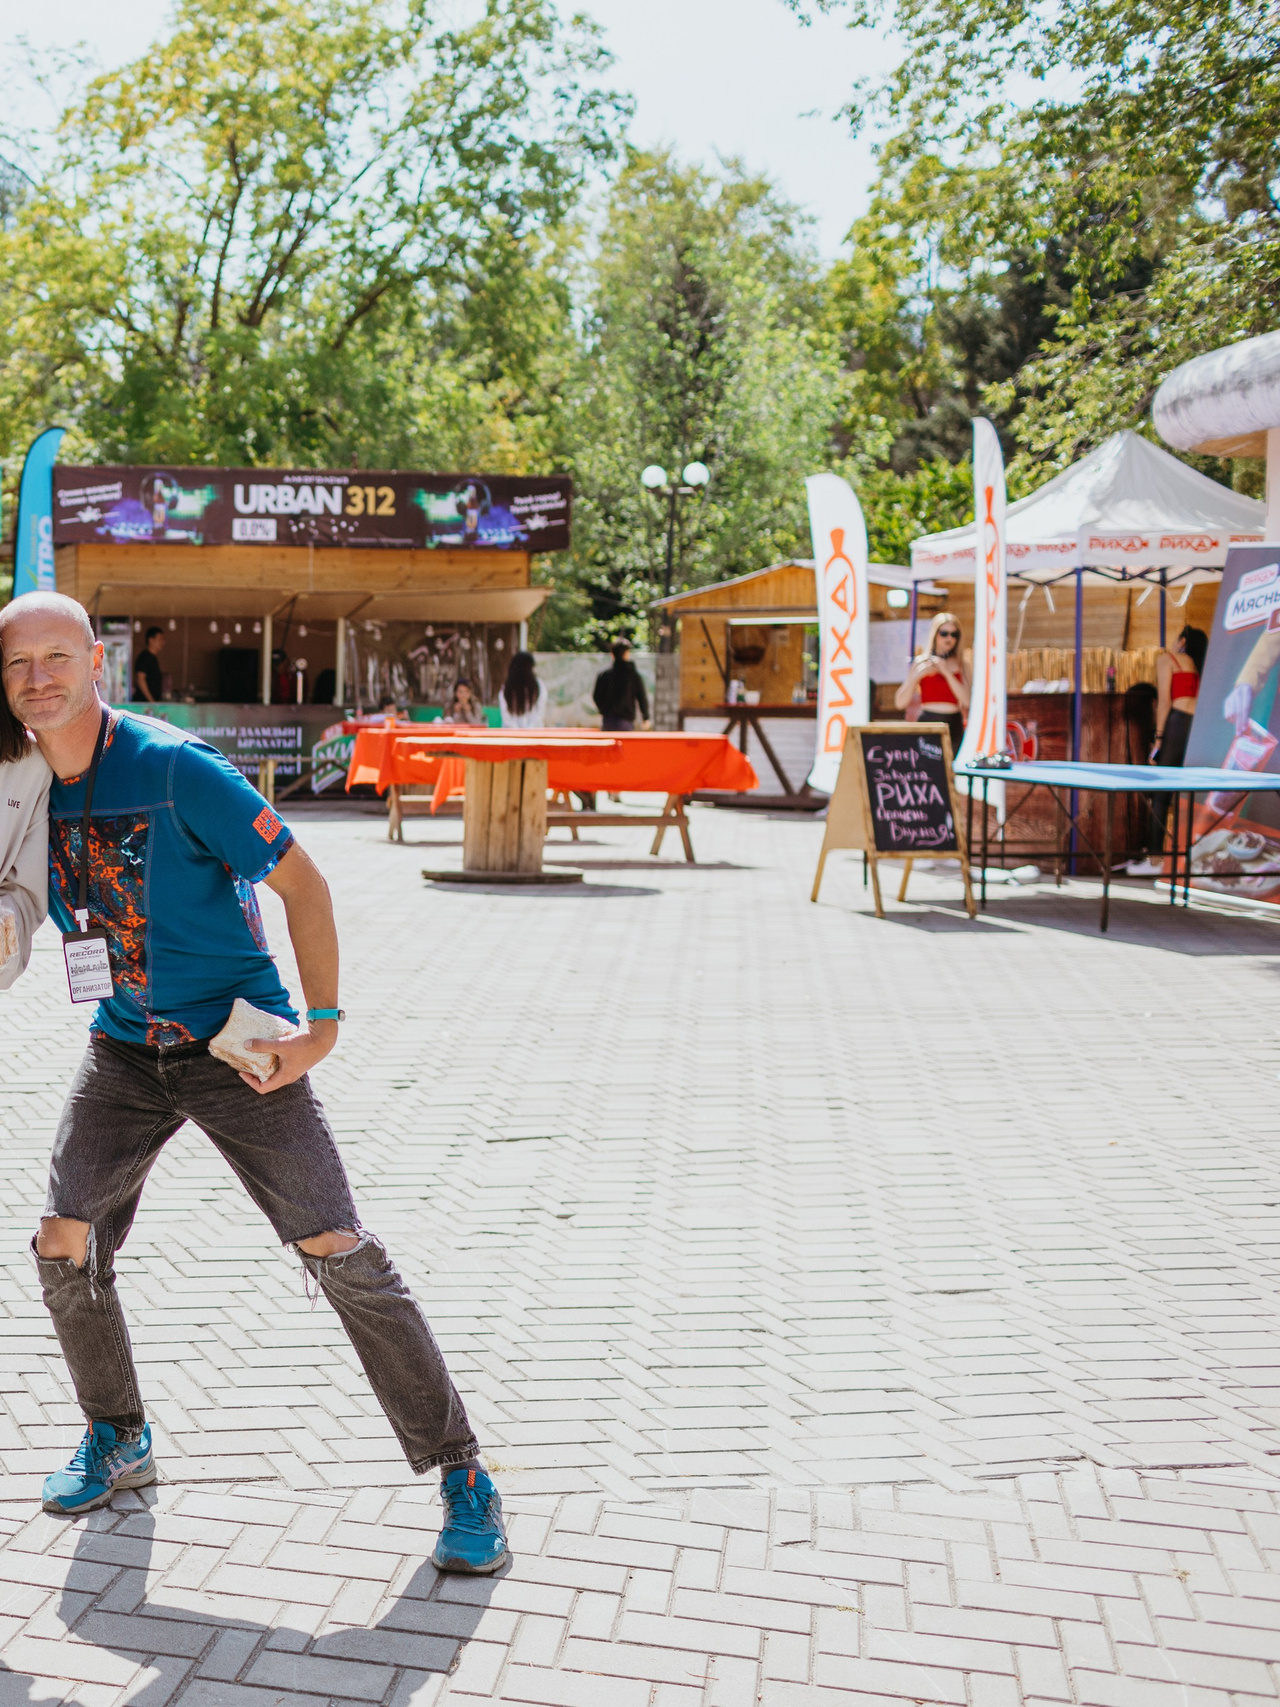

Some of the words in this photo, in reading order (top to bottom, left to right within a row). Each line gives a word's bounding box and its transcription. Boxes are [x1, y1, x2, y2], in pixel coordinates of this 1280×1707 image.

[234, 484, 342, 515] URBAN
[345, 485, 396, 516] 312
[867, 746, 919, 768] Супер
[7, 798, 21, 809] LIVE
[70, 948, 105, 958] RECORD
[72, 983, 111, 995] ОРГАНИЗАТОР
